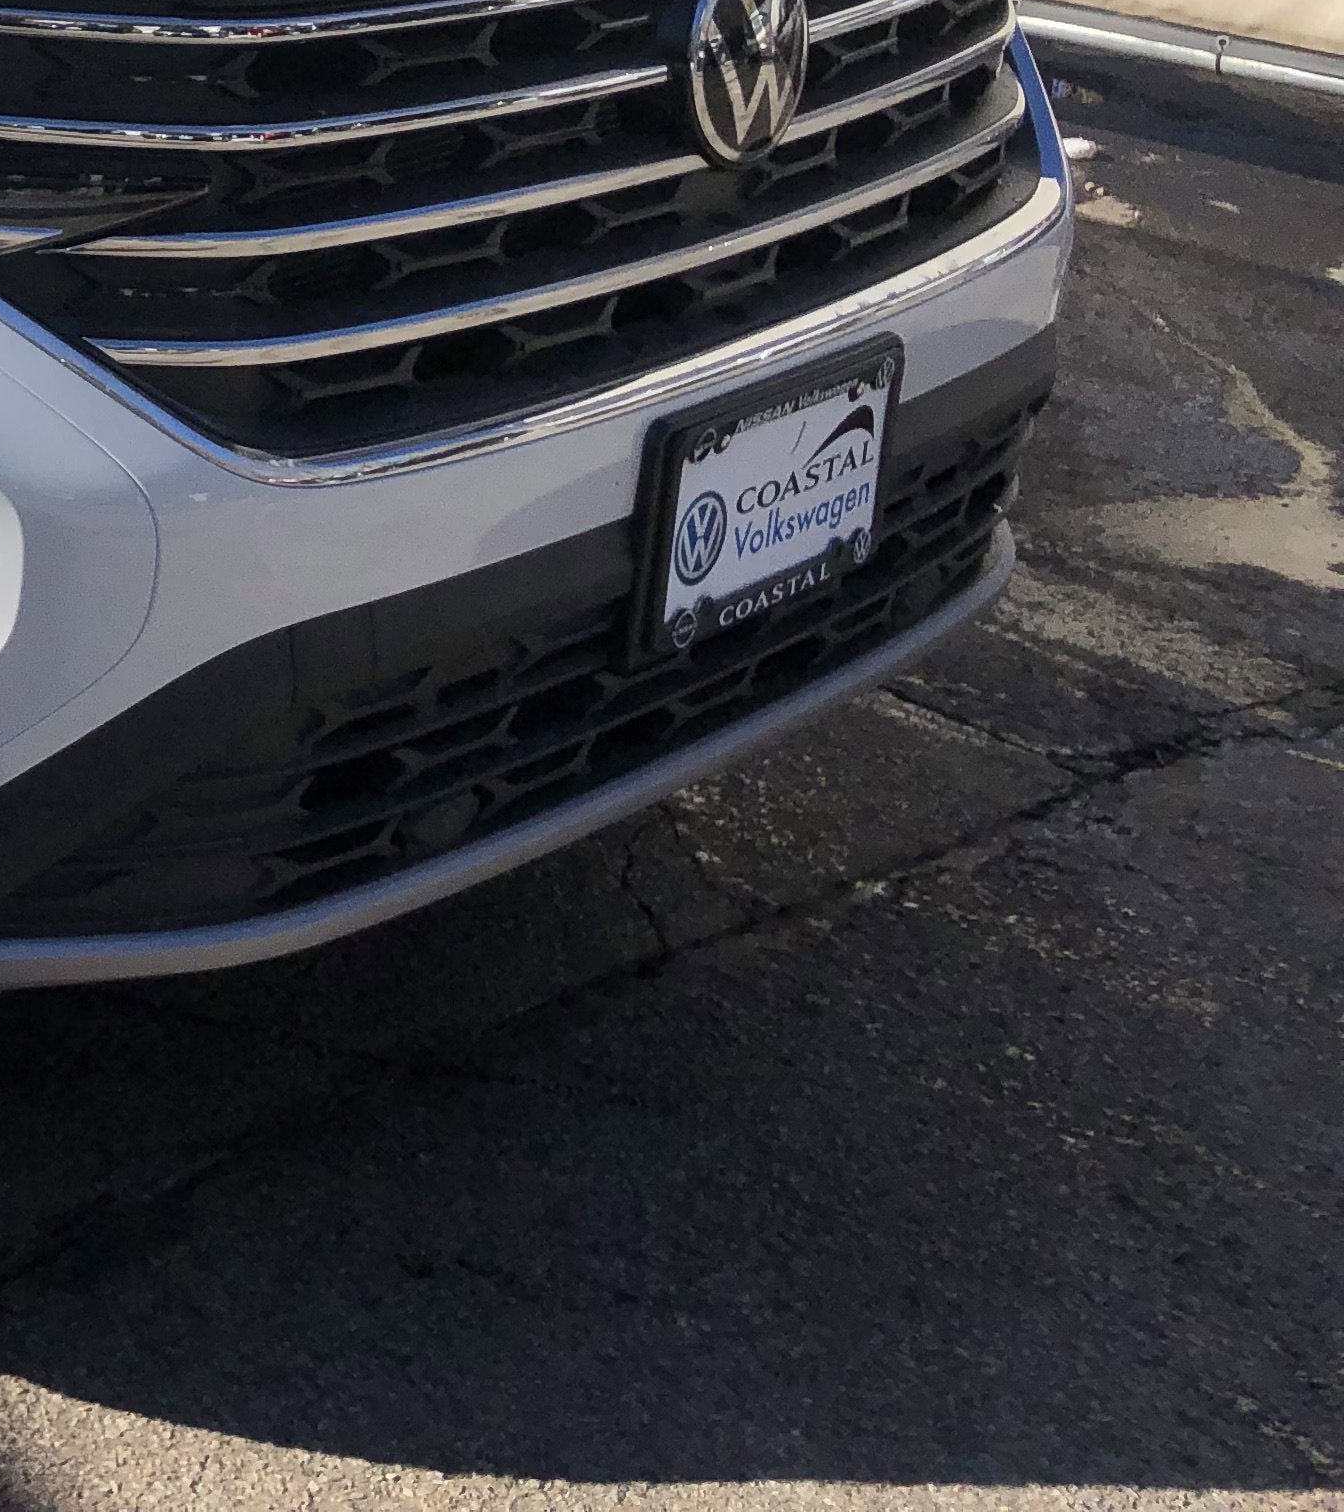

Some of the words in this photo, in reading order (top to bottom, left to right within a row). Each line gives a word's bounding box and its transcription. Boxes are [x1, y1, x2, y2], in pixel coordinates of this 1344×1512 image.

[735, 440, 875, 515] COASTAL
[734, 482, 871, 562] Volkswagen
[718, 561, 831, 627] COASTAL
